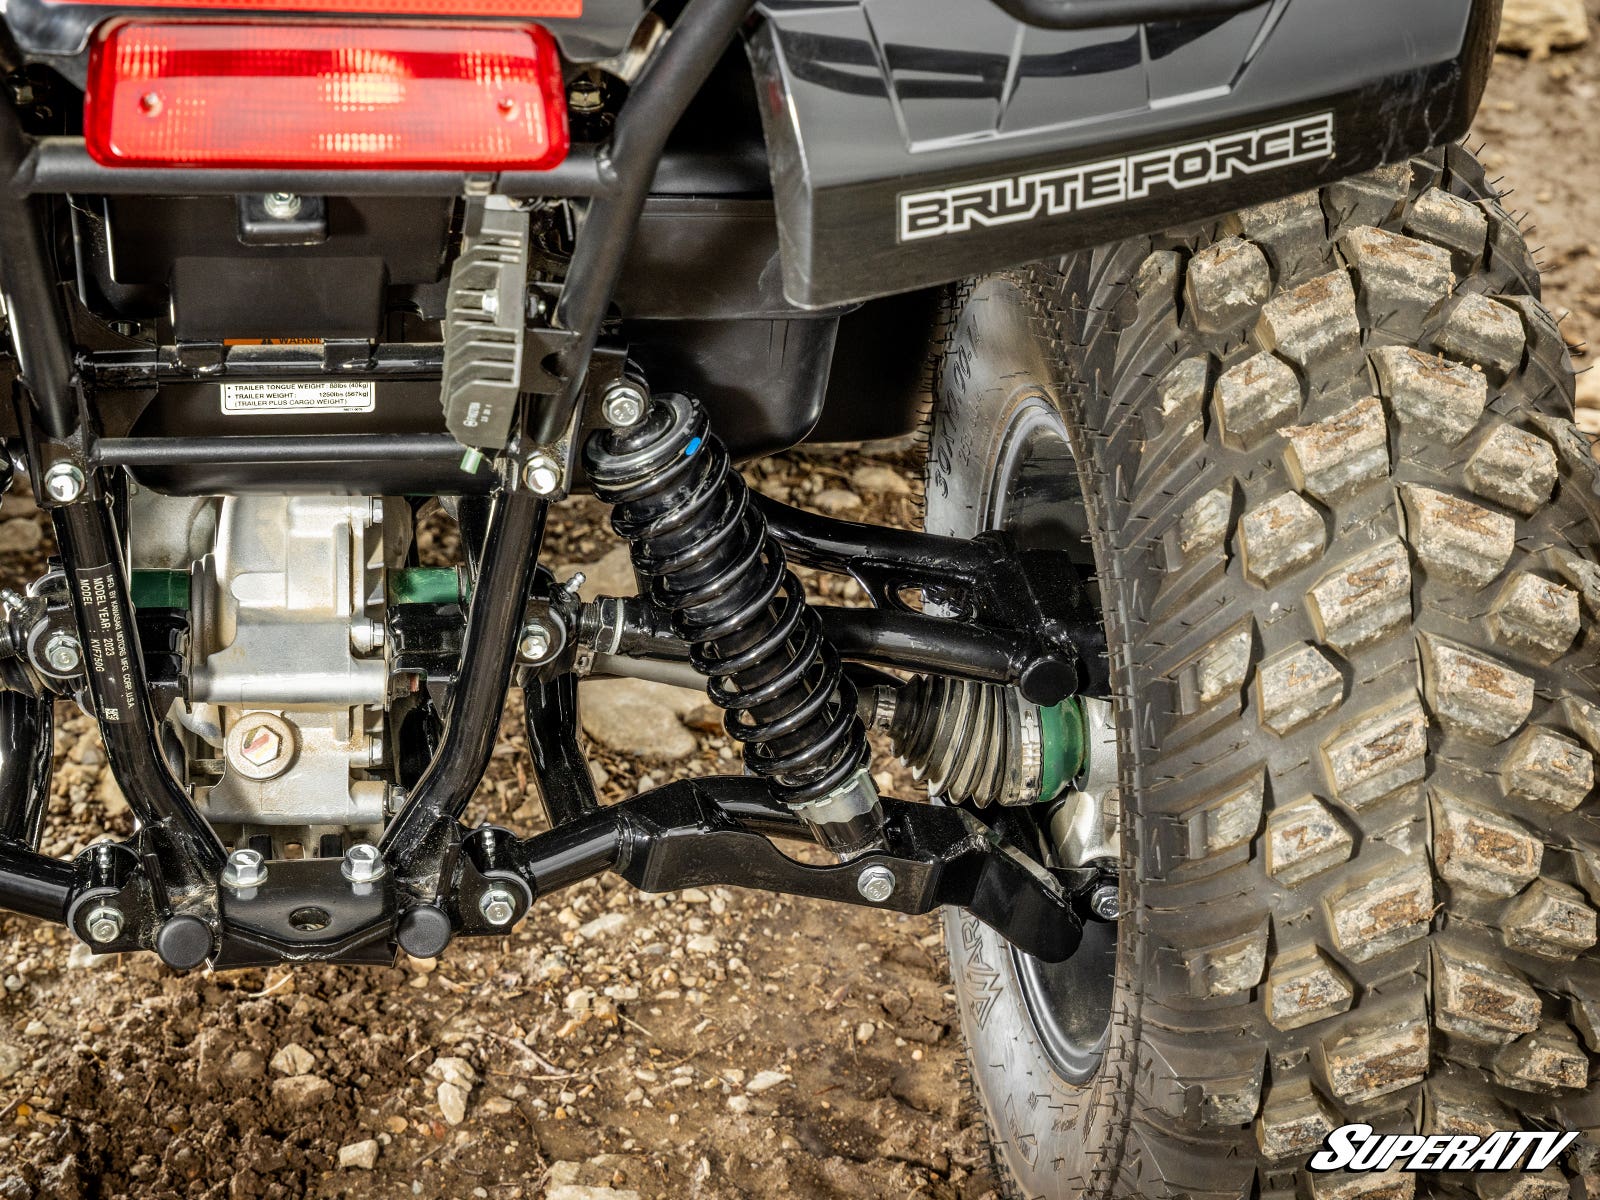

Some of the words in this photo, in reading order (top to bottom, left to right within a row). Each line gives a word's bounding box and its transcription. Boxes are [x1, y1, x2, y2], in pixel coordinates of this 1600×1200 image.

[108, 590, 116, 598] BY
[80, 578, 93, 606] MODEL
[91, 639, 105, 672] KVF750G
[93, 577, 106, 606] MODEL
[104, 638, 116, 656] 2023
[110, 600, 122, 630] KAWASAKI
[116, 631, 126, 656] MOTORS
